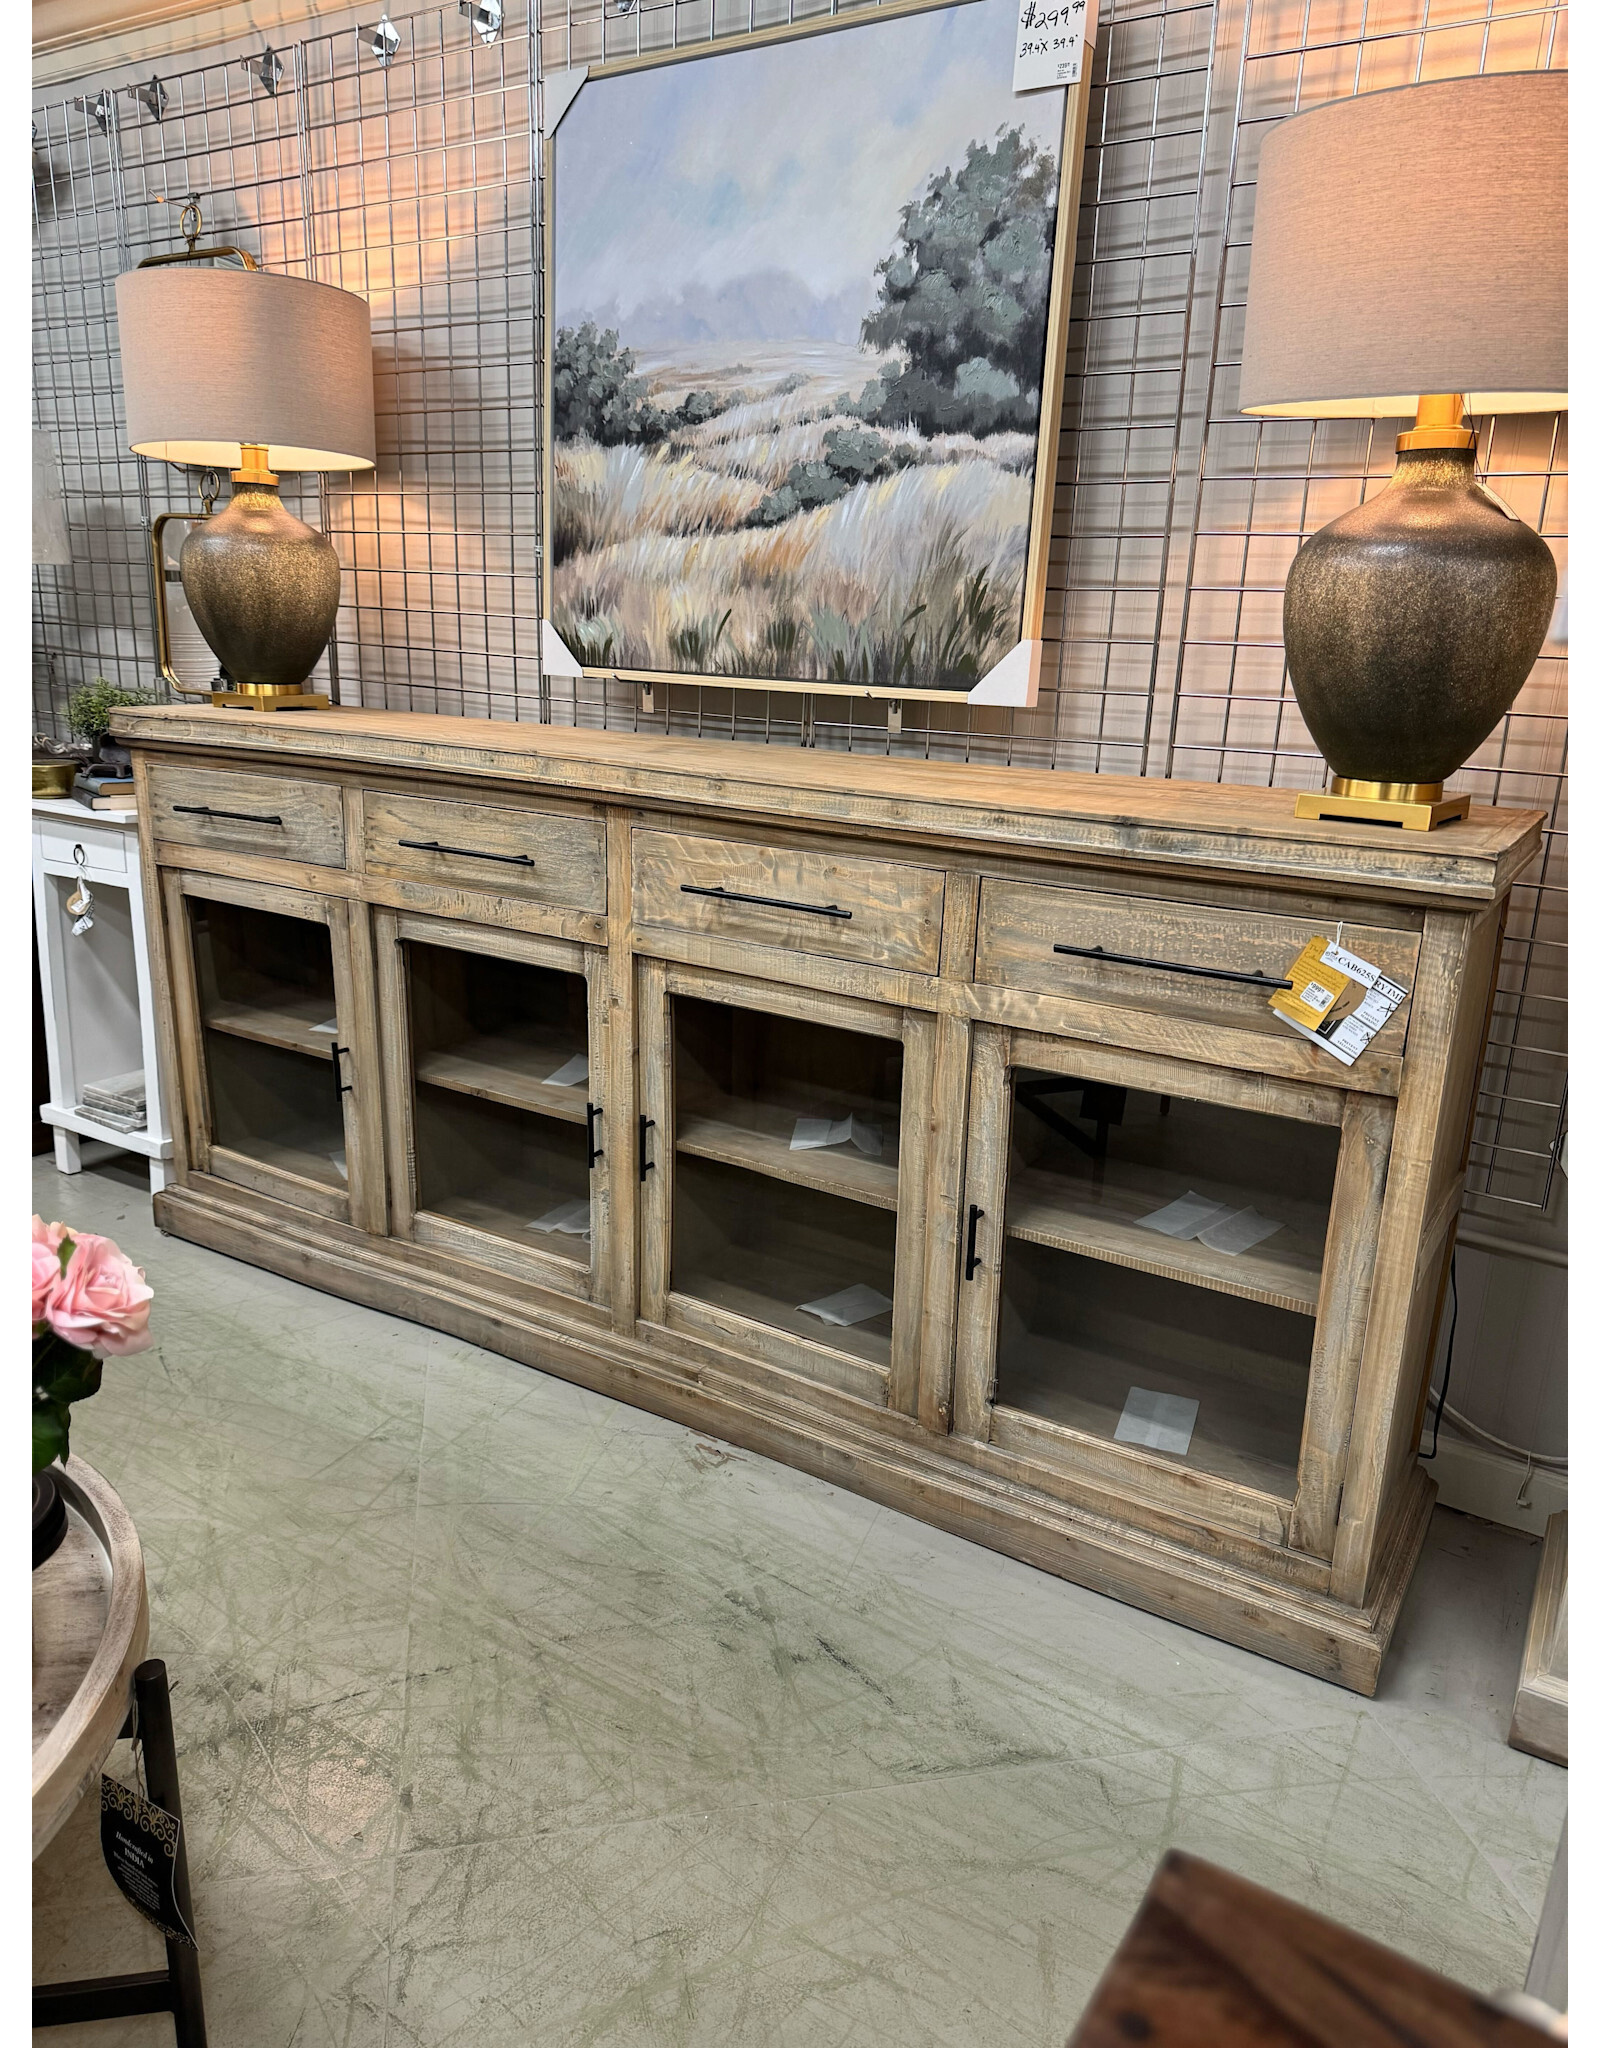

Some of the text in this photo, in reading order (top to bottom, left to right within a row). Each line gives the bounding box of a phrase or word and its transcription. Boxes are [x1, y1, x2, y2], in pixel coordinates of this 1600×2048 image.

[1337, 956, 1377, 983] CAB625S
[115, 1831, 148, 1859] Handcrafted
[124, 1847, 145, 1869] INDIA
